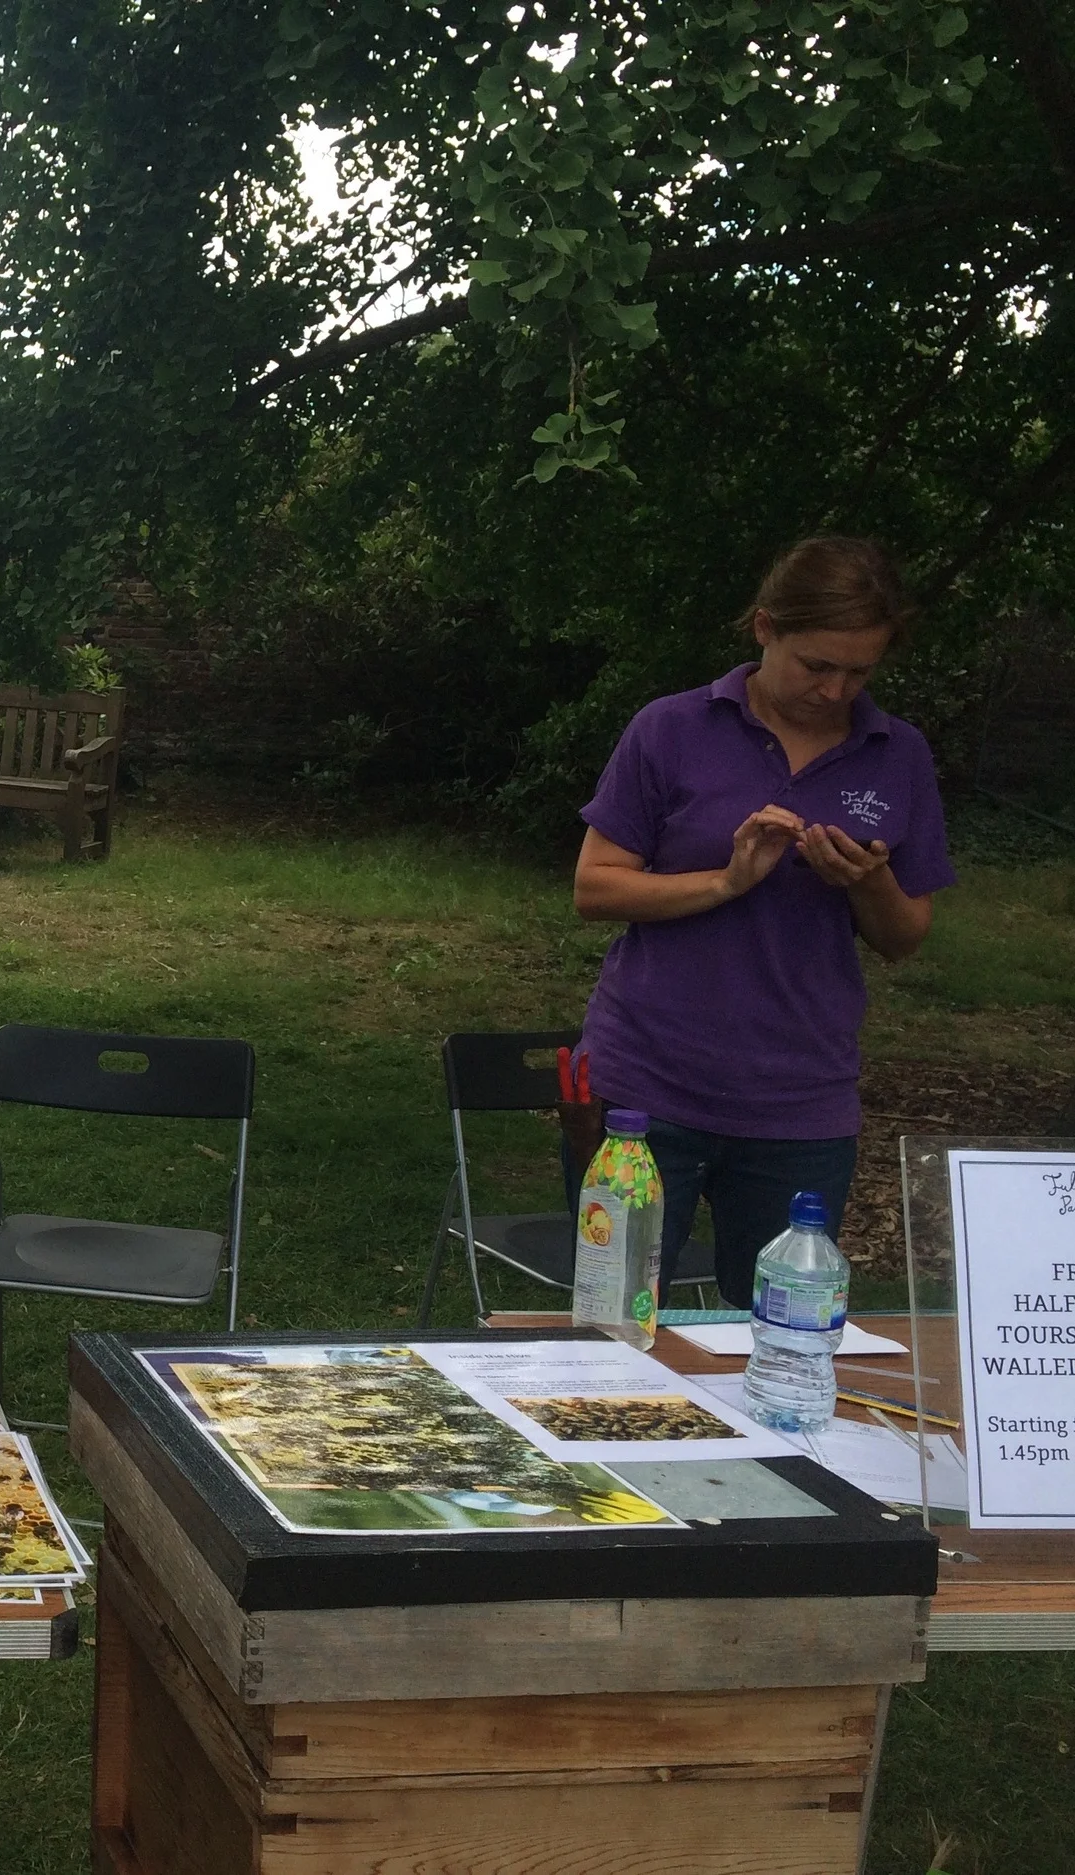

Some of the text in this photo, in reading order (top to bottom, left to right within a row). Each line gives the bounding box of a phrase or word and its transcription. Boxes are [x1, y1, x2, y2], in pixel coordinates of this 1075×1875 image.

[997, 1326, 1075, 1344] TOURS
[988, 1416, 1068, 1438] Starting
[999, 1445, 1070, 1466] 1.45pm
